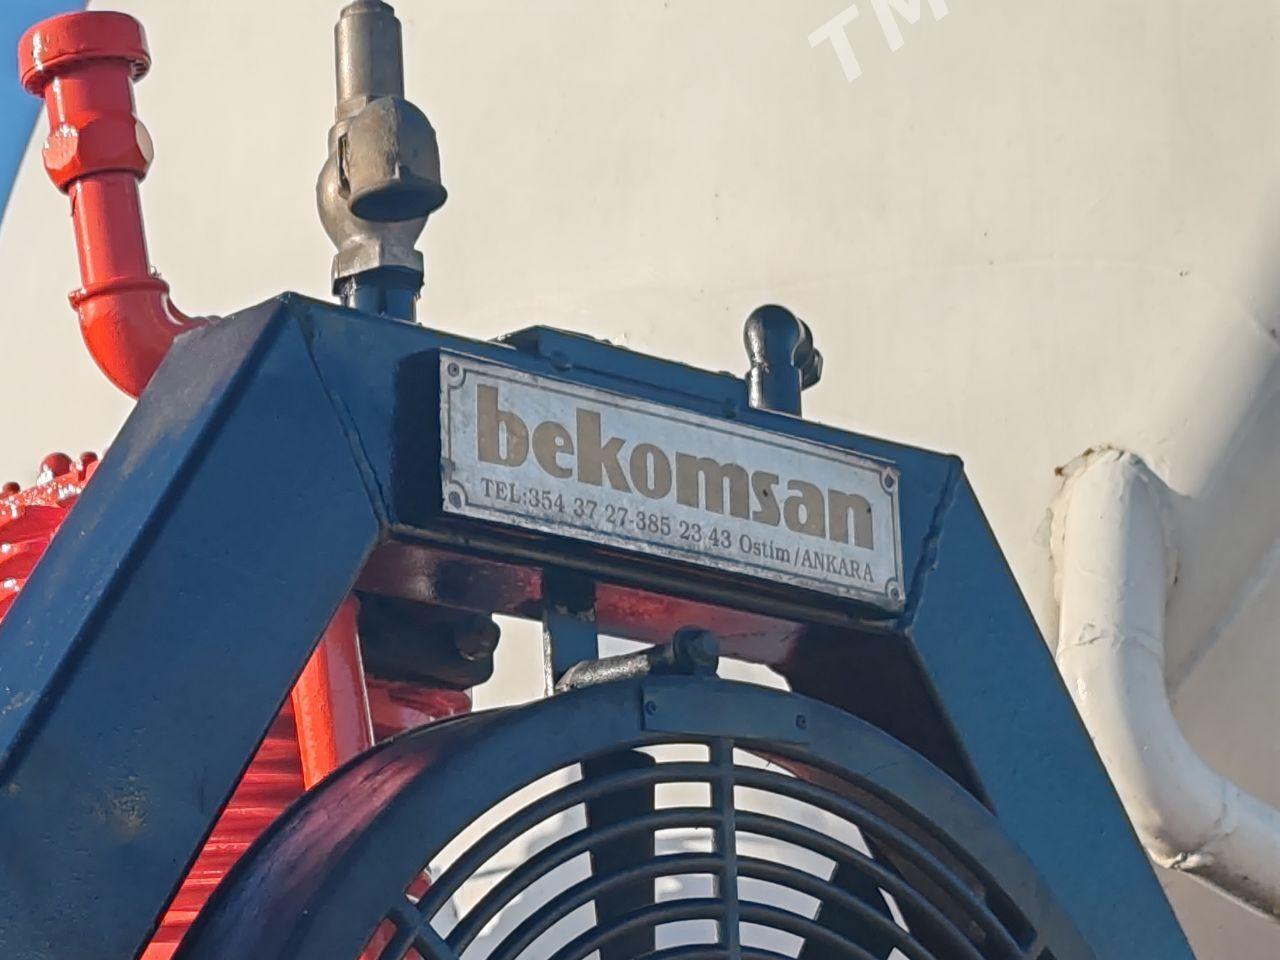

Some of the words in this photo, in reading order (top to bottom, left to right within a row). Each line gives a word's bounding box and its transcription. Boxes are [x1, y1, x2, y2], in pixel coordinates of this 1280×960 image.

[476, 383, 874, 550] bekomsan
[480, 477, 565, 513] TEL:354
[573, 497, 596, 519] 37
[604, 505, 671, 537] 27-385
[679, 519, 703, 543] 23
[708, 525, 733, 549] 43
